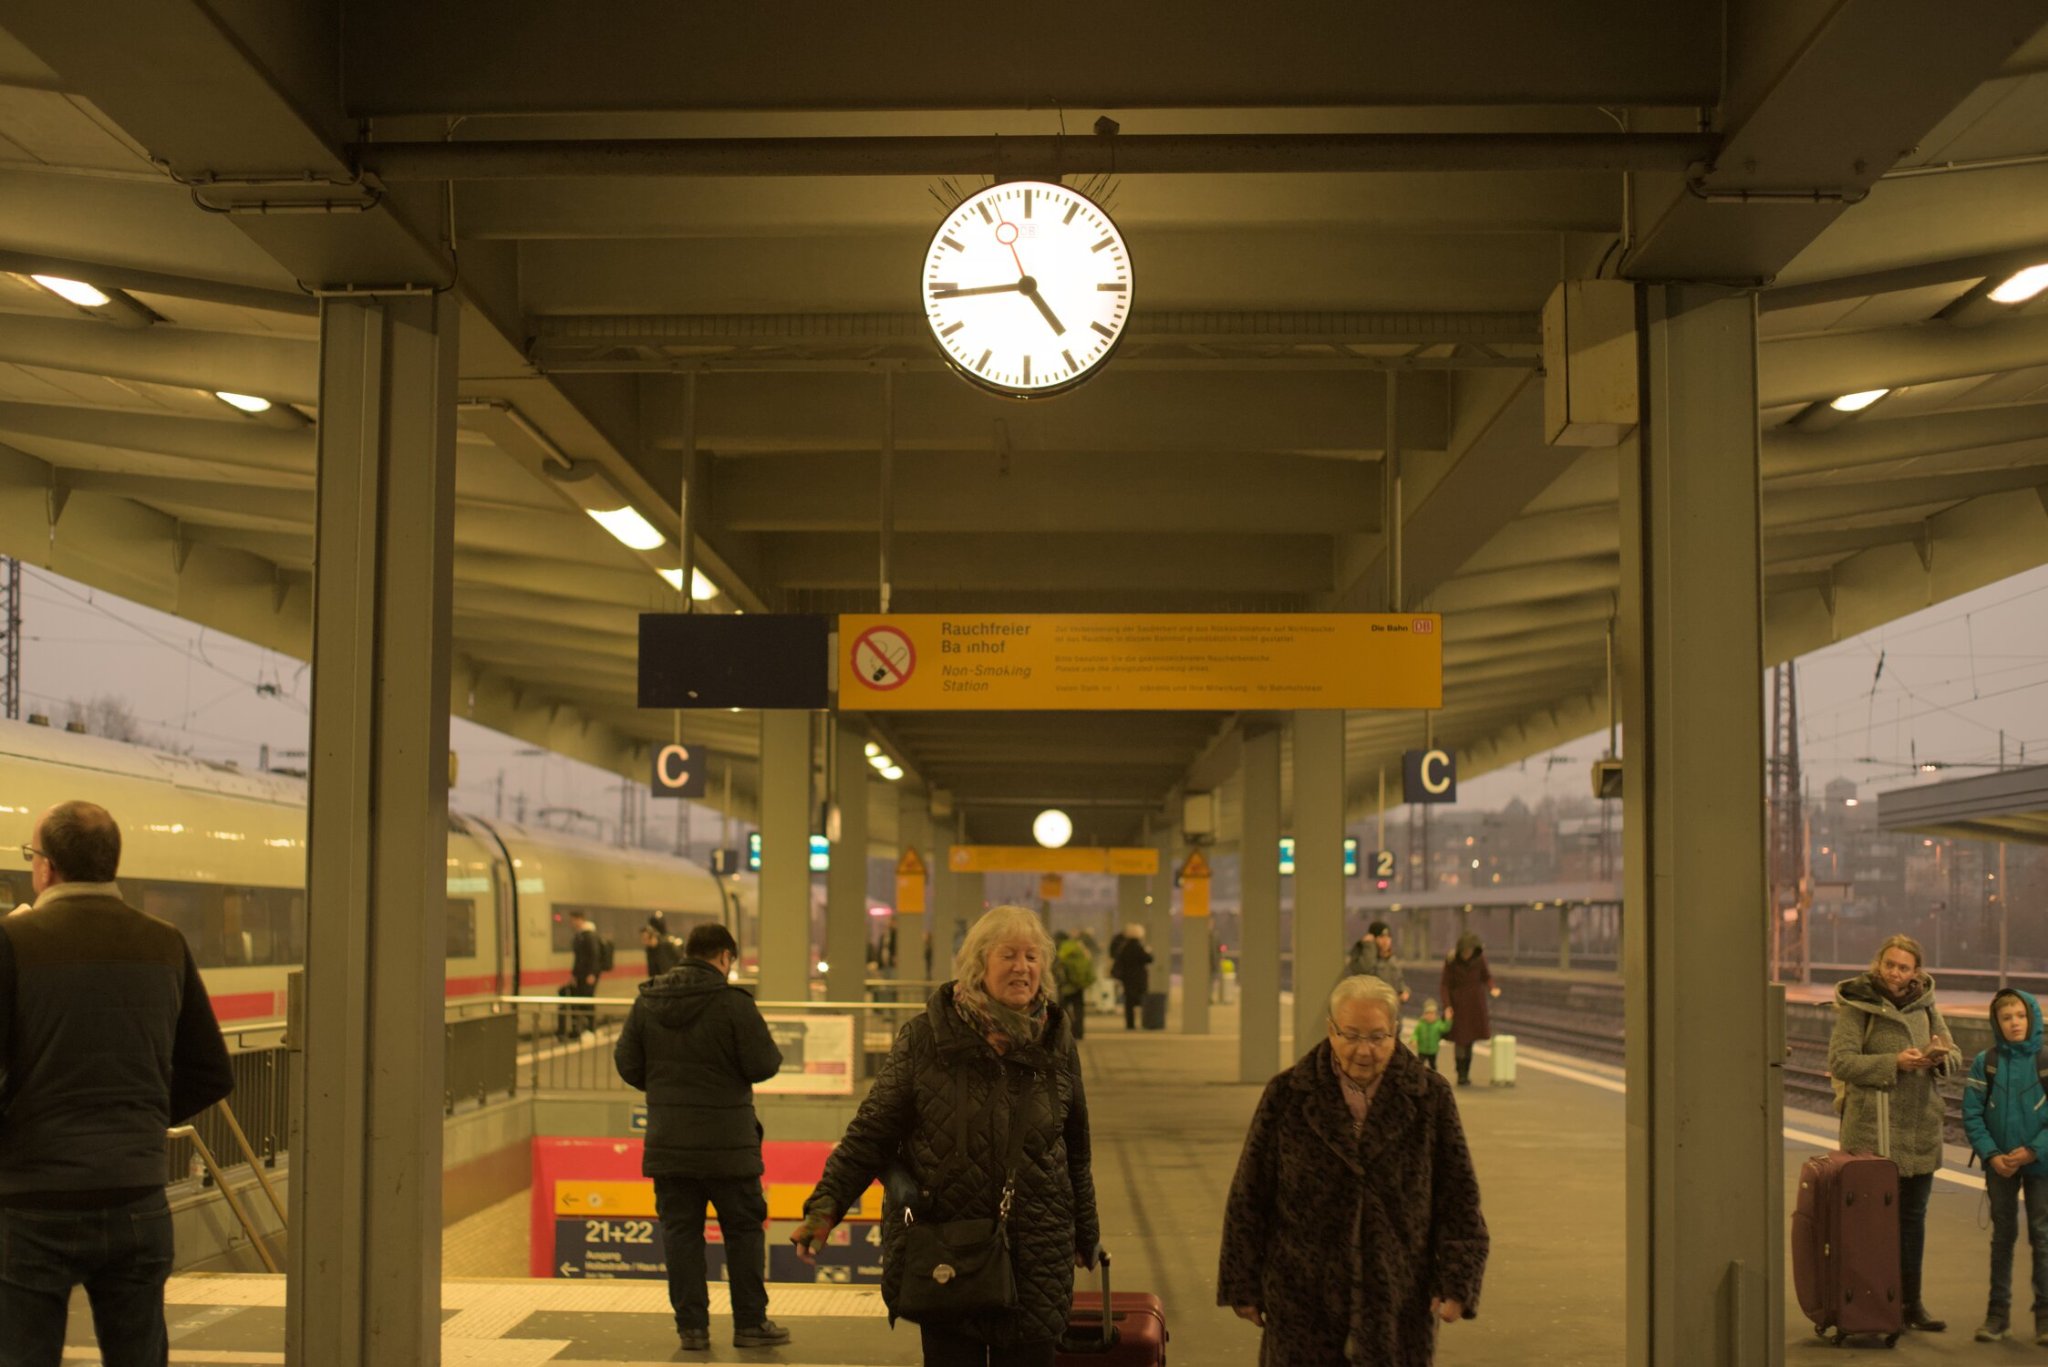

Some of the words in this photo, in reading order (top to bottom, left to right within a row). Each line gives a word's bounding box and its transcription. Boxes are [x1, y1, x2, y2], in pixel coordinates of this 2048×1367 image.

[941, 622, 1030, 635] Rauchfreier
[1387, 624, 1408, 632] Bahn
[942, 664, 1031, 678] Non-Smoking
[943, 679, 989, 692] Station
[657, 744, 689, 788] C
[1421, 750, 1450, 794] C
[714, 849, 724, 872] 1
[1377, 850, 1393, 876] 2
[585, 1219, 653, 1243] 21+22
